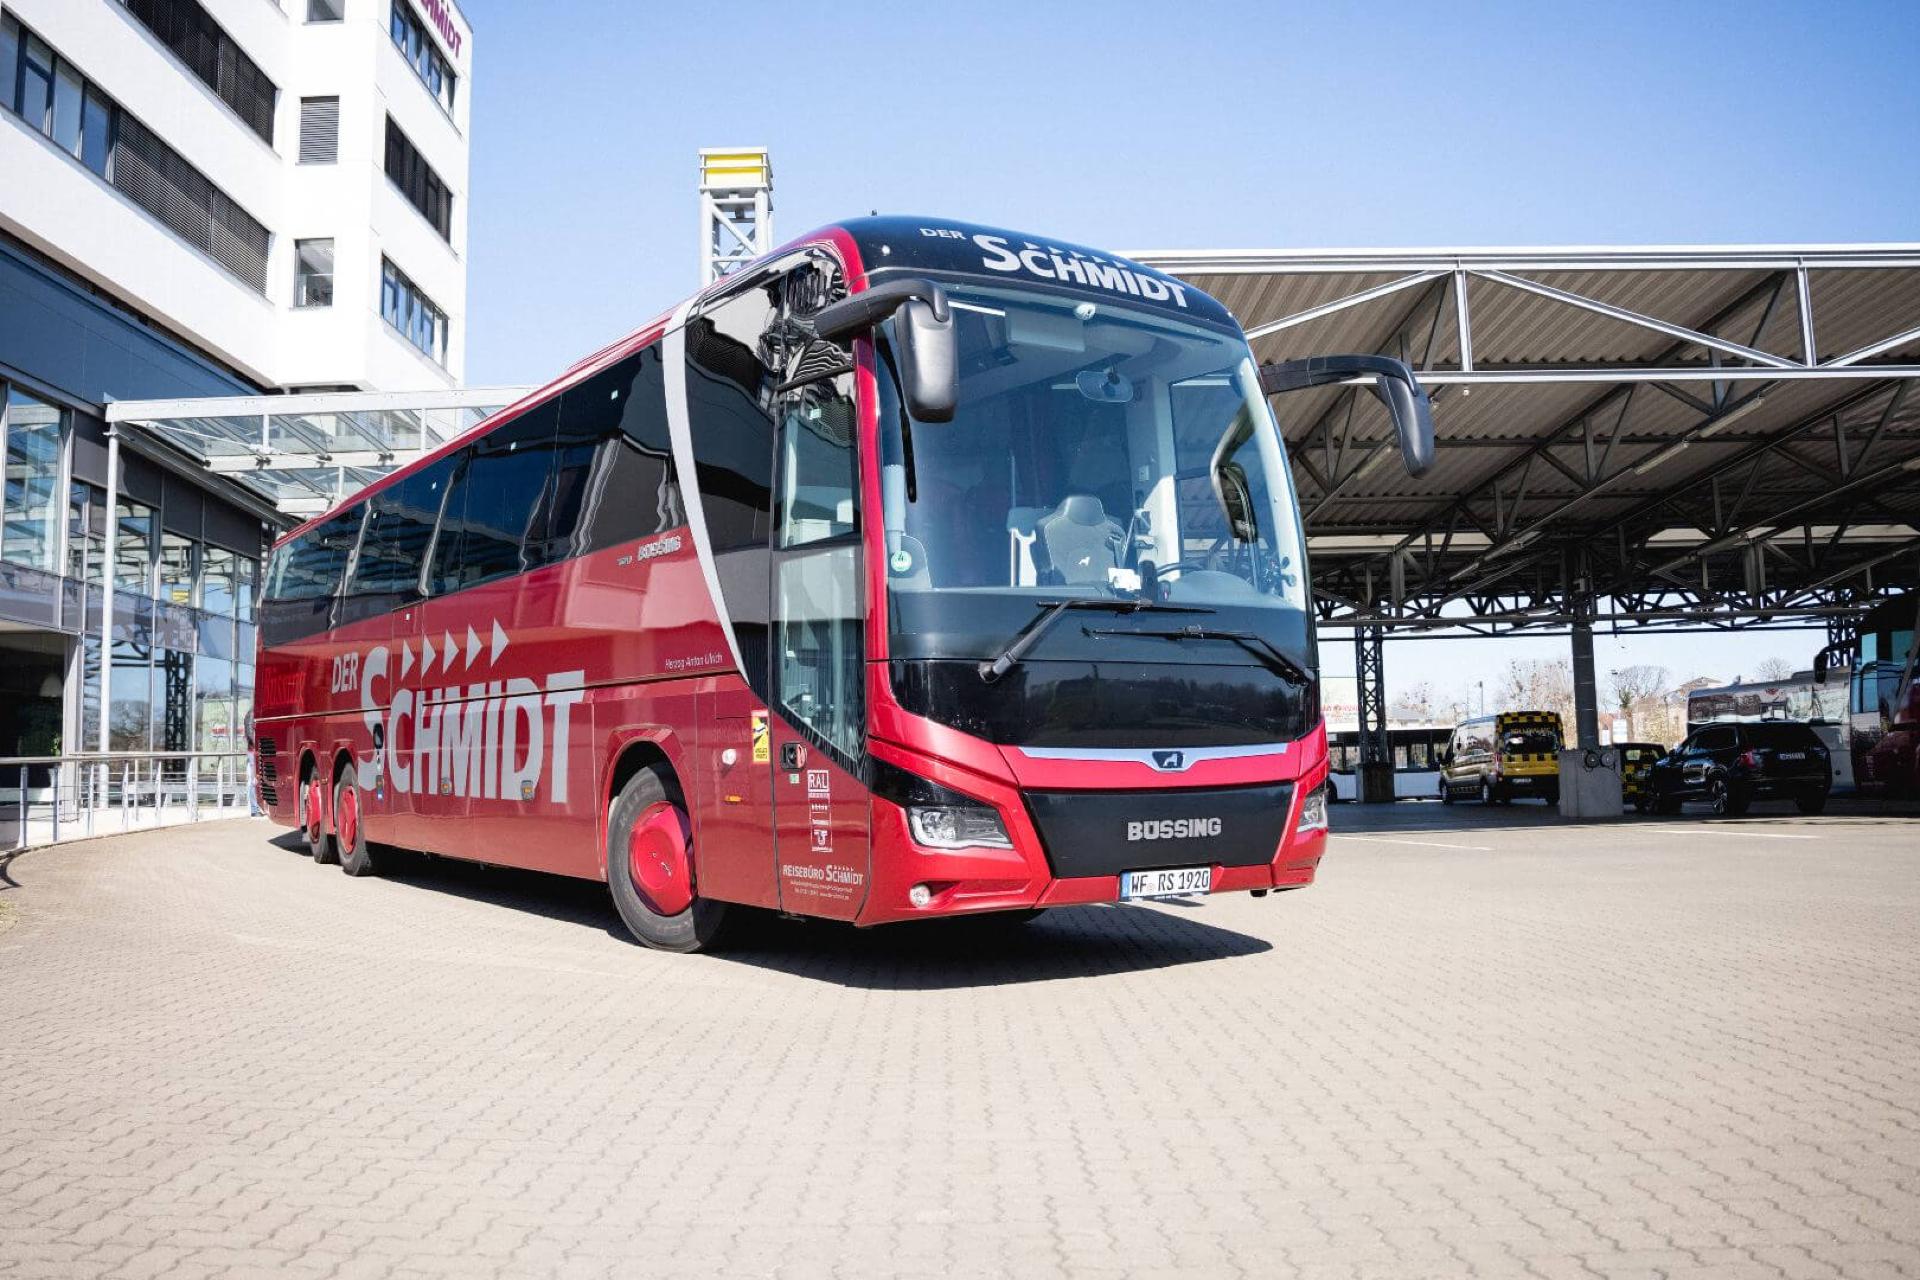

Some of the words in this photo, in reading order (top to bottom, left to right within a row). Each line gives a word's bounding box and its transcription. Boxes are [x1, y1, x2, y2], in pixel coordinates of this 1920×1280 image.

[919, 228, 966, 240] DER
[972, 234, 1188, 307] SCHMIDT
[331, 652, 359, 694] DER
[358, 646, 585, 804] SCHMIDT
[808, 773, 828, 789] RAL
[782, 864, 825, 881] REISEBÜRO
[825, 864, 864, 887] SCHMIDT
[1131, 874, 1149, 894] WF
[1157, 872, 1174, 892] RS
[1178, 870, 1209, 890] 1920
